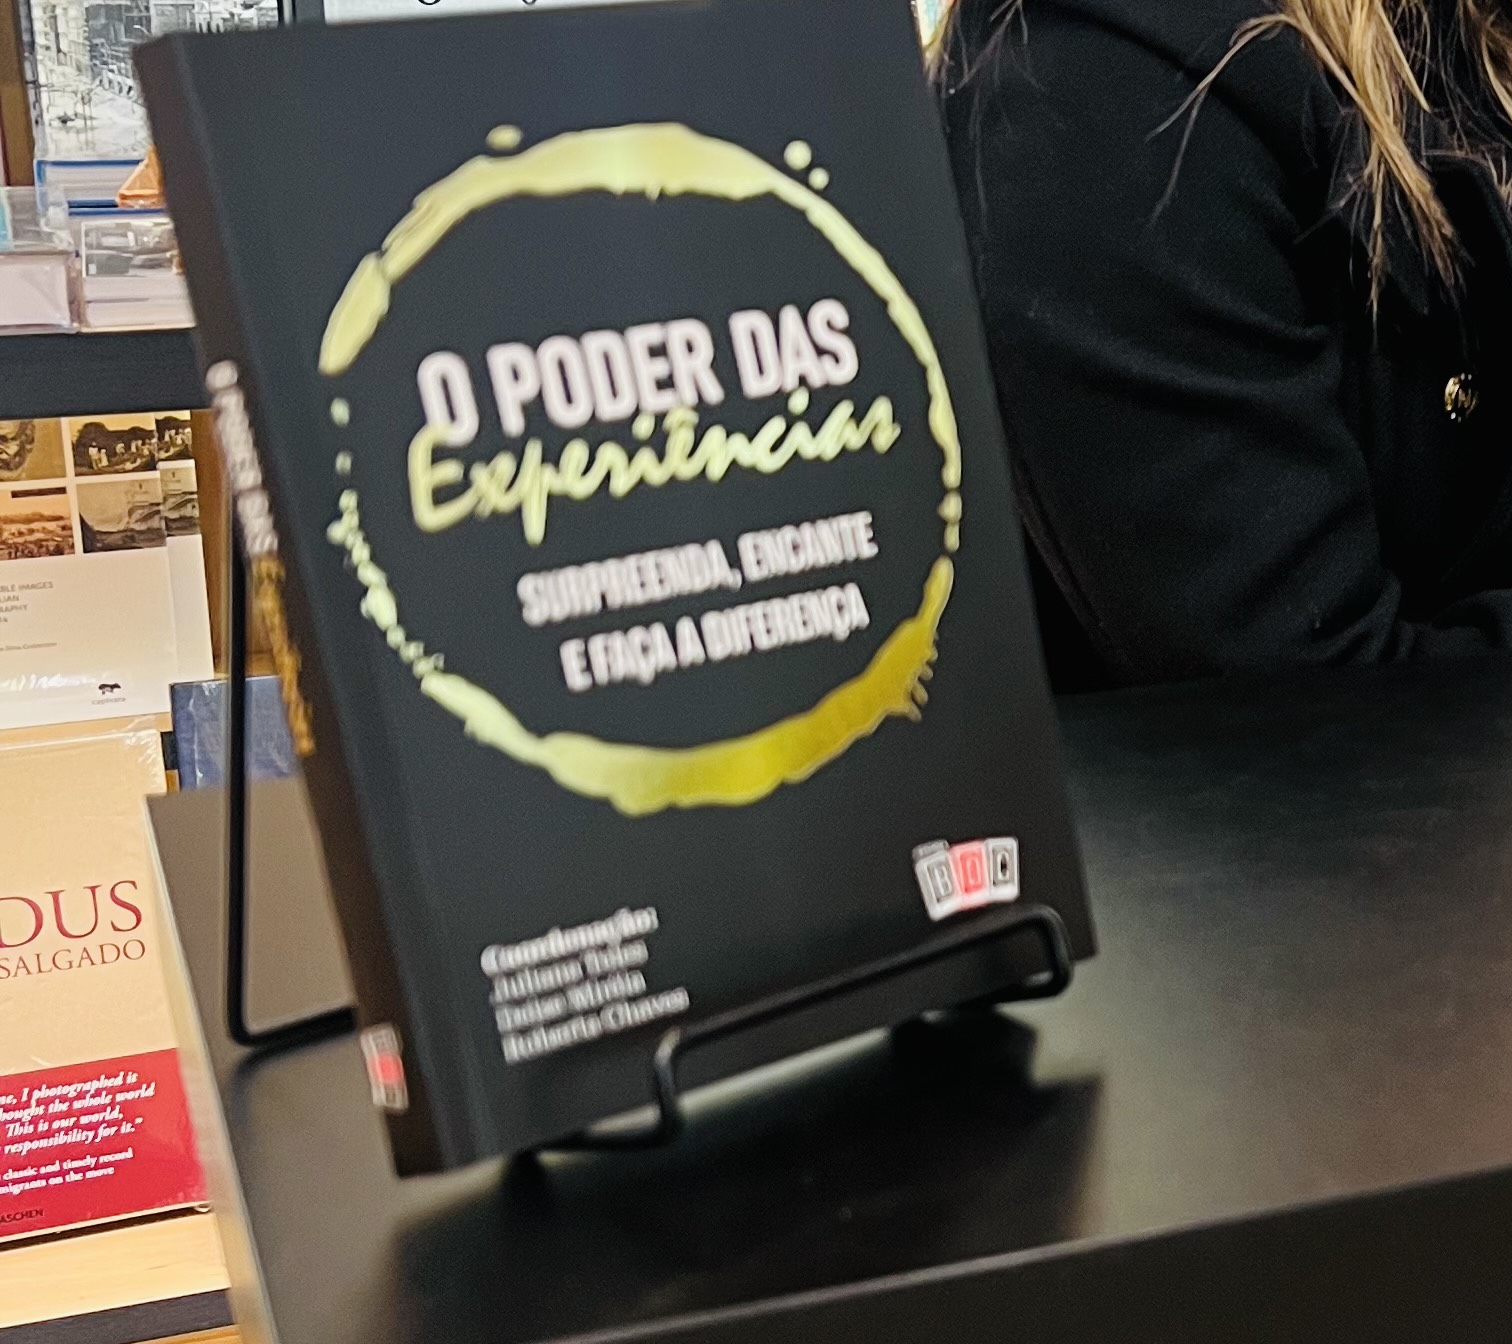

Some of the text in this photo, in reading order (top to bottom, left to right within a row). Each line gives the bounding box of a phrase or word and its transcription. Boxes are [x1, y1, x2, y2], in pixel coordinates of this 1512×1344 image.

[417, 298, 859, 448] O PODER DAS
[407, 387, 901, 547] Experiências
[18, 580, 54, 591] IMAGES
[516, 510, 878, 627] SURPREENDA, ENCANTE
[559, 581, 870, 693] E FAÇA A DIFERENÇA
[0, 880, 143, 949] DUS
[0, 938, 146, 980] SALGADO
[21, 1071, 139, 1109] I photographed it
[48, 1081, 156, 1114] the whole world
[4, 1123, 119, 1156] responsibility for
[6, 1104, 124, 1138] This is our world,
[3, 1146, 135, 1181] classic and timely record
[48, 1166, 116, 1186] on the move
